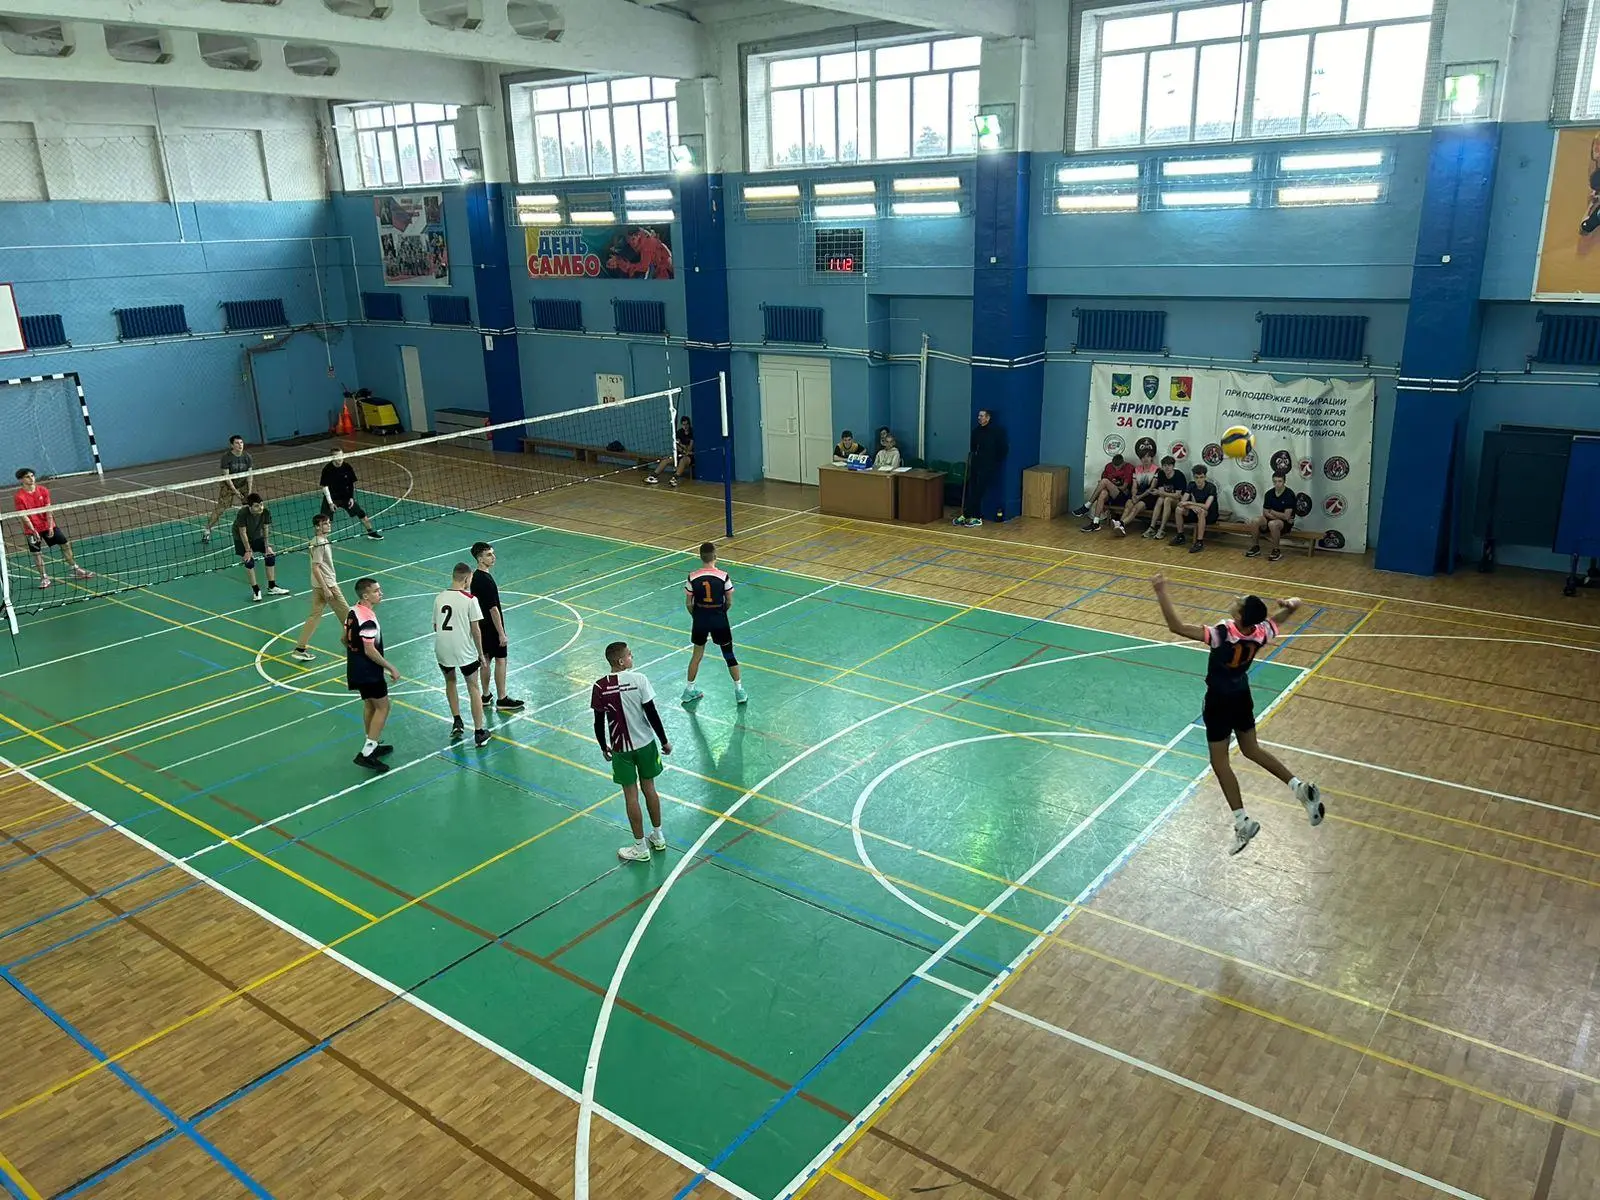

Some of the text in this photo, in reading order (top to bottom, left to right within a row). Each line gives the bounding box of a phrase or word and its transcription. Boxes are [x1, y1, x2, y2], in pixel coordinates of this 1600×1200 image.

[538, 236, 587, 258] ДЕНЬ
[528, 254, 600, 276] САМБО
[1110, 402, 1190, 417] #ПРИМОРЬЕ
[1324, 408, 1346, 416] КРАЯ
[1116, 416, 1179, 431] ЗА СПОРТ
[702, 581, 713, 603] 1
[441, 604, 453, 631] 2
